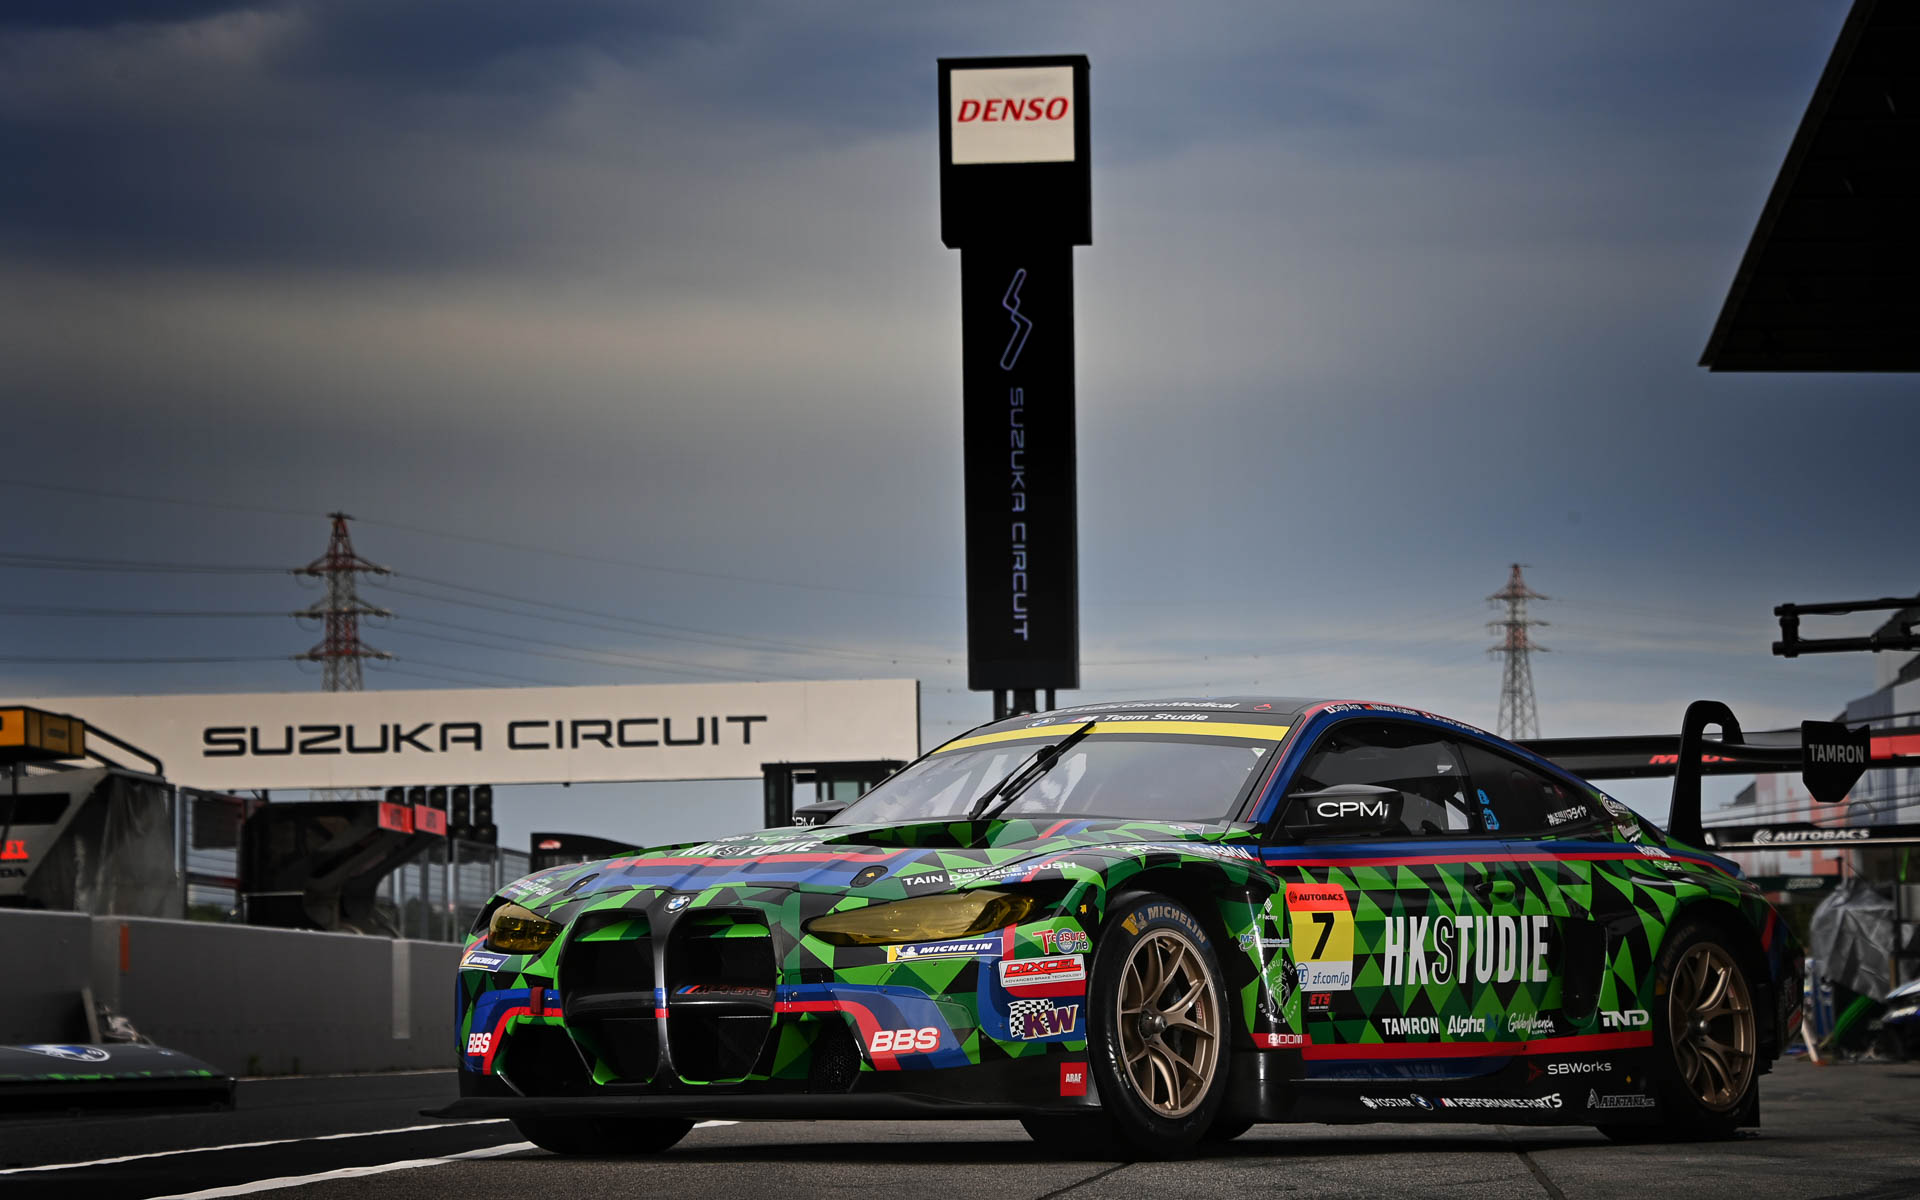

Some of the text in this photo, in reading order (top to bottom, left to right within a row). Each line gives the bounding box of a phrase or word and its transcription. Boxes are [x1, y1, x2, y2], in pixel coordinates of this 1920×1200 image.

[957, 96, 1069, 122] DENSO
[1010, 387, 1028, 640] SUZUKA CIRCUIT
[1151, 713, 1209, 721] Studie
[203, 715, 768, 757] SUZUKA CIRCUIT
[1809, 744, 1864, 763] TAMRON
[1773, 829, 1870, 842] AUTOBACS
[903, 874, 944, 886] TAIN
[949, 865, 1023, 881] DOUBLE
[1027, 861, 1077, 871] PUSH
[1298, 893, 1344, 901] AUTOBACS
[1147, 906, 1207, 944] MICHELIN
[1310, 912, 1335, 960] 7
[920, 942, 993, 954] MICHELIN
[1004, 958, 1082, 977] DIXCEL
[1312, 972, 1350, 986] zf.com/jp
[1023, 1005, 1079, 1039] KW
[1382, 1017, 1439, 1035] TAMRON
[1447, 1015, 1485, 1037] Alpha
[468, 1033, 492, 1054] BBS
[870, 1027, 939, 1052] BBS
[1547, 1061, 1612, 1075] SBWorks
[1371, 1098, 1415, 1107] YOSTAR
[1456, 1099, 1528, 1109] PERFORMANCE
[1526, 1092, 1563, 1109] PARTS
